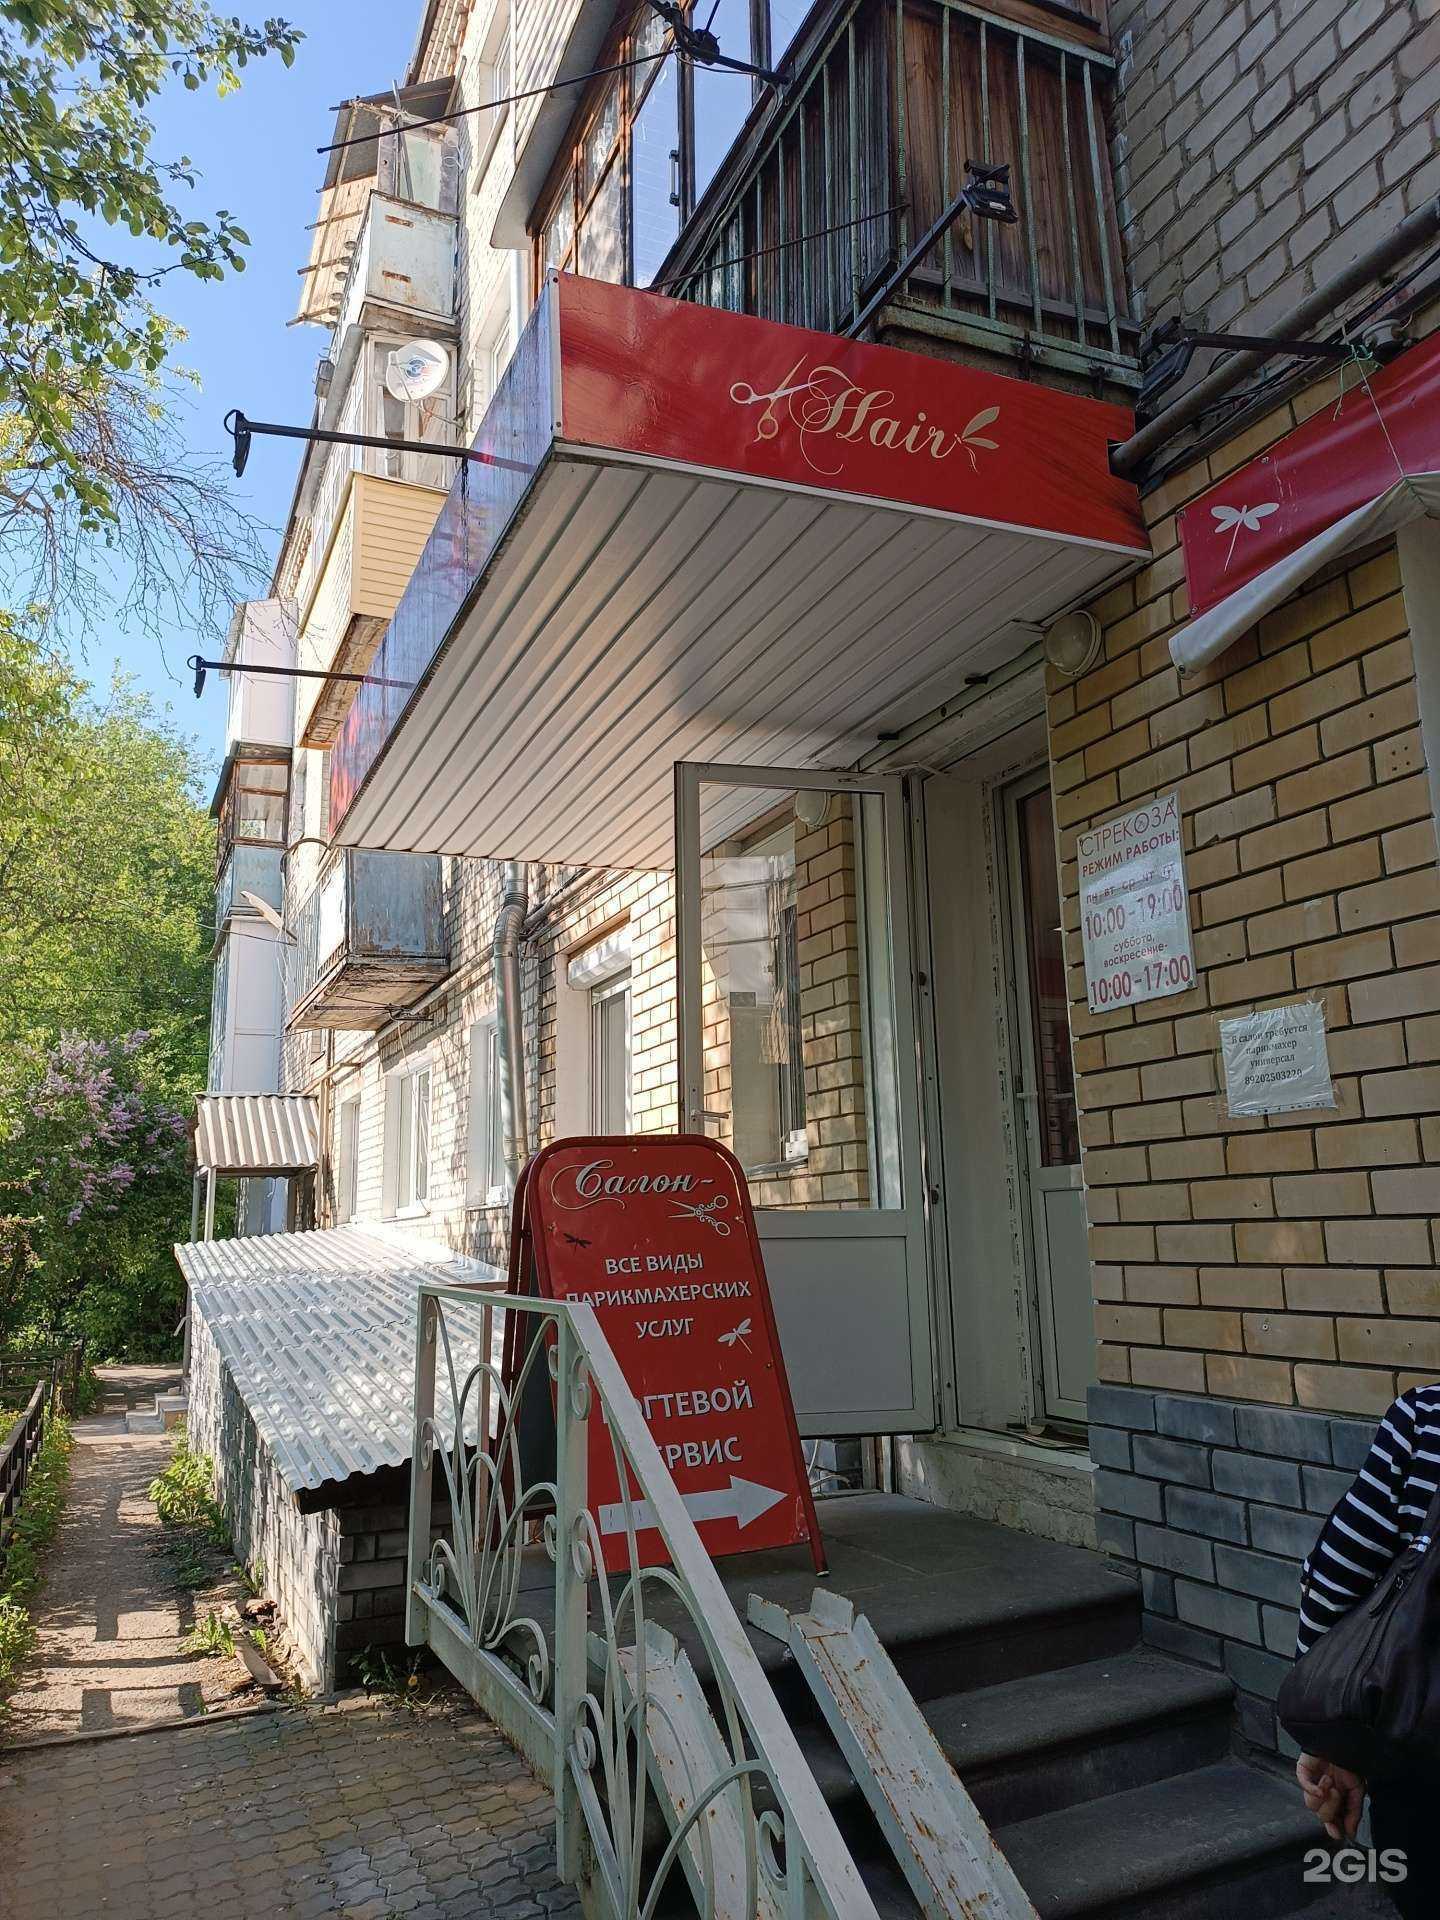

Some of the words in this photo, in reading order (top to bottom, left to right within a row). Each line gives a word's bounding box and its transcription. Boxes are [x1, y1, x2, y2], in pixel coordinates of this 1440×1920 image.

[790, 366, 956, 475] Hair
[1080, 801, 1177, 857] СТРЕКОЗА
[1082, 851, 1123, 877] РЕЖИМ
[1126, 829, 1180, 860] РАБОТЫ:
[1113, 934, 1155, 953] суббота,
[1264, 1024, 1308, 1040] требуется
[605, 1256, 642, 1275] ВСЕ
[646, 1253, 703, 1274] ВИДЫ
[635, 1317, 694, 1339] УСЛУГ
[600, 1379, 754, 1424] ГТЕВОЙ
[657, 1436, 743, 1471] РВИС
